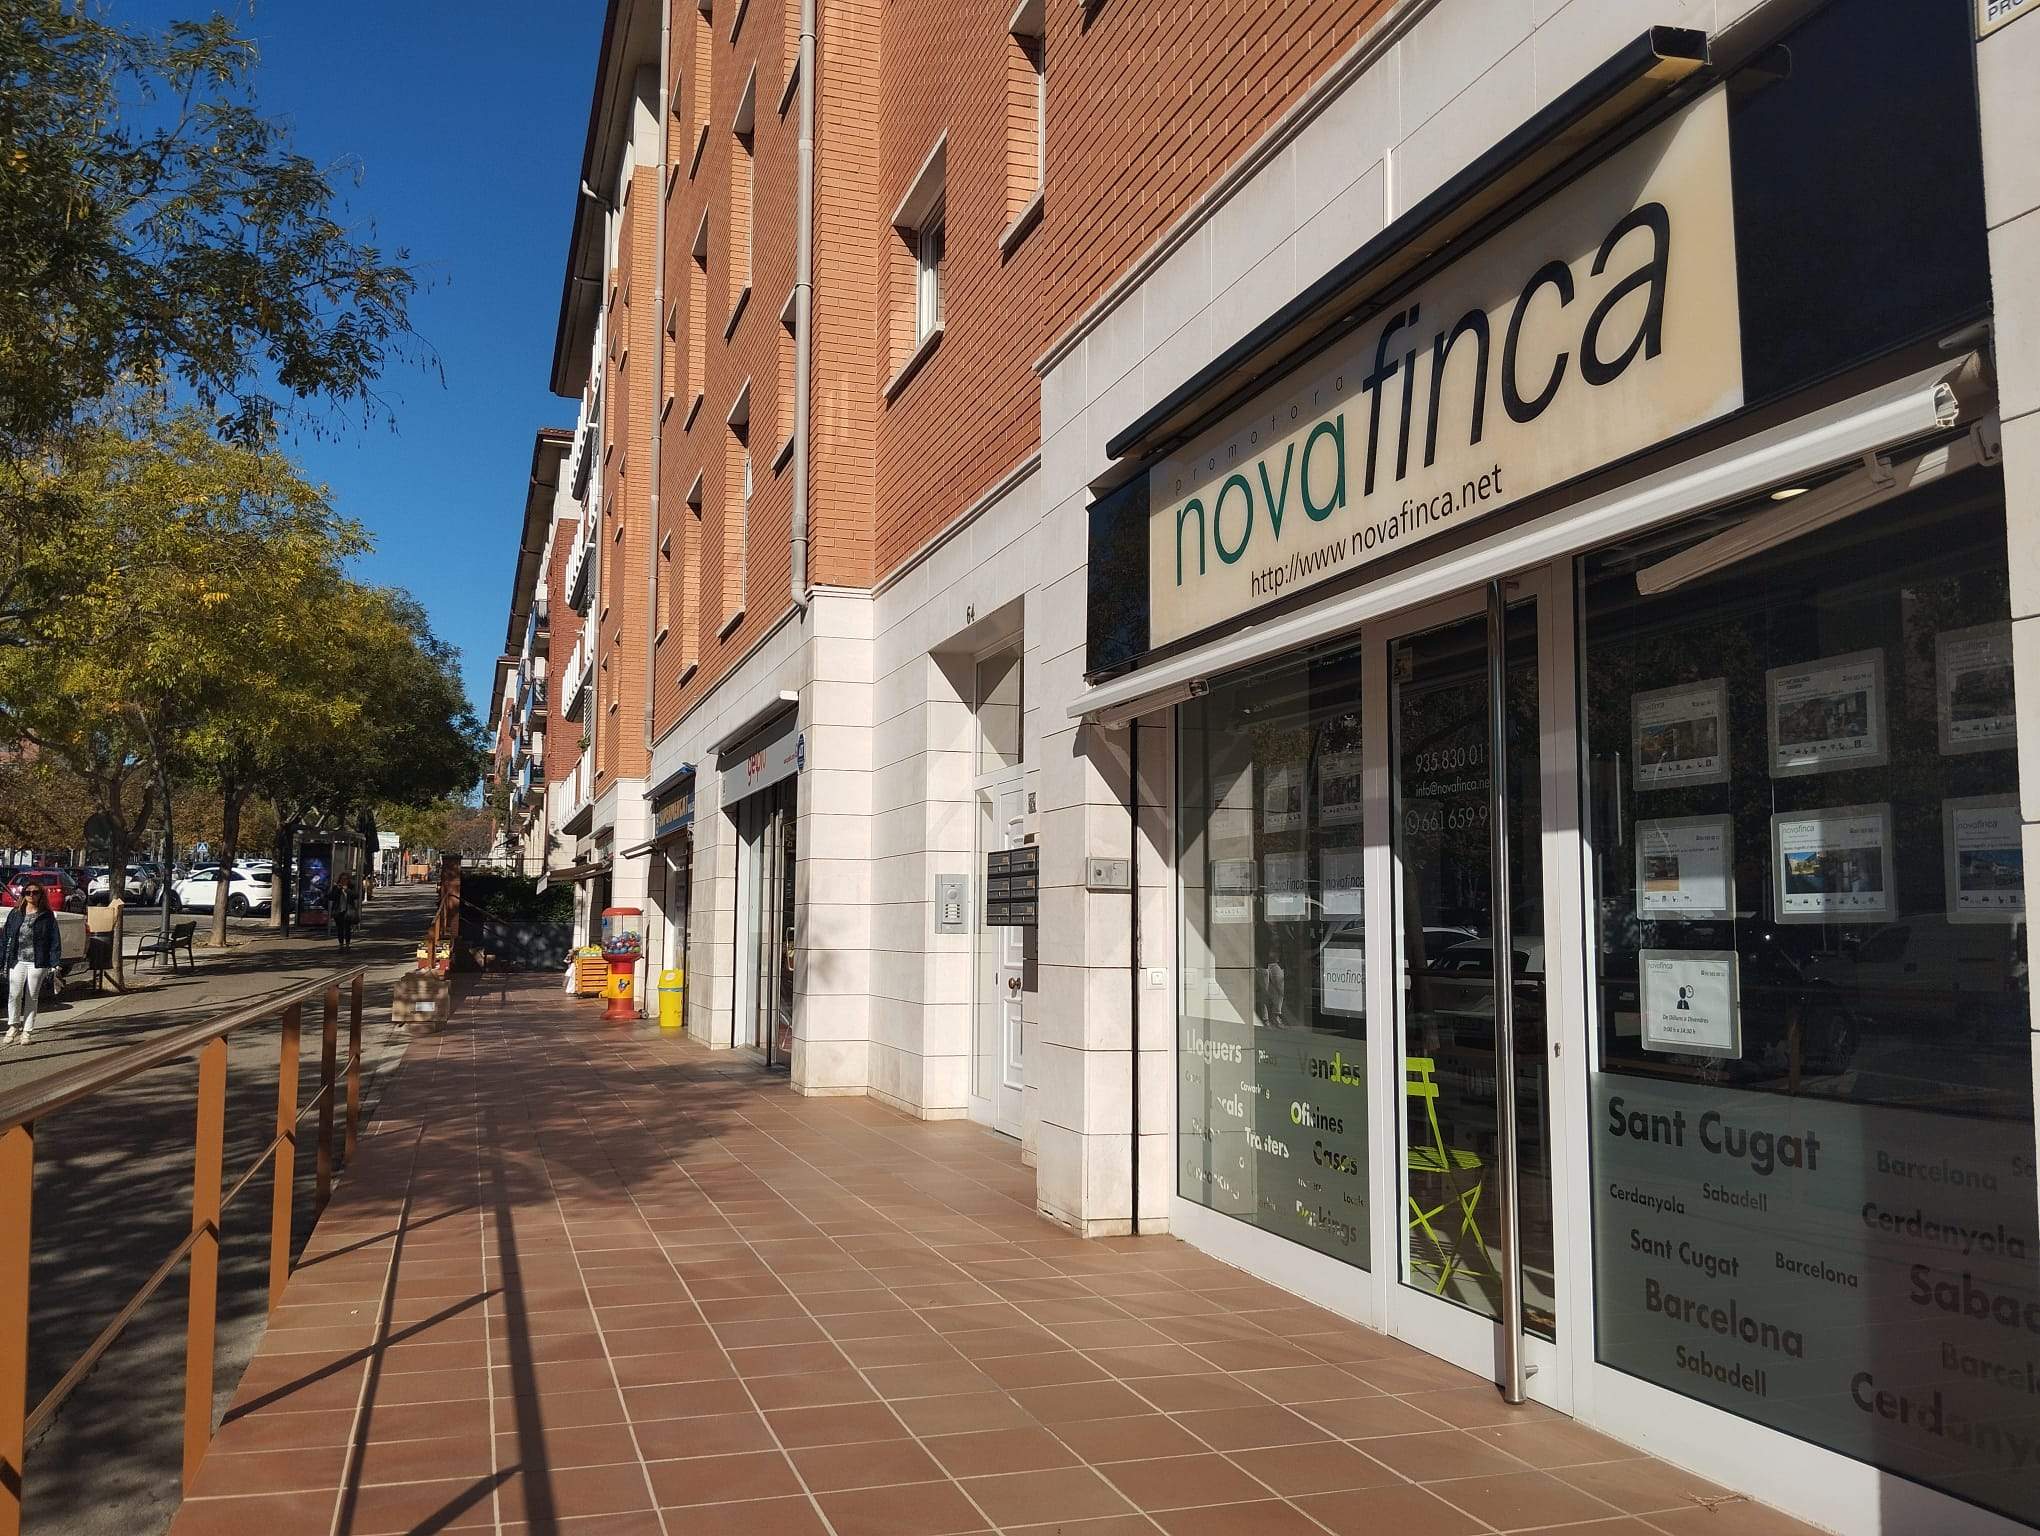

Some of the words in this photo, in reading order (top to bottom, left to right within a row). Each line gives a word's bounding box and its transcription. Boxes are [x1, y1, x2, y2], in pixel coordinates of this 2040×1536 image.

[1175, 376, 1343, 496] promotora
[967, 602, 975, 624] 64
[1415, 752, 1438, 773] 935
[1442, 747, 1465, 769] 830
[1416, 776, 1490, 797] info@novafinca.ne
[1422, 811, 1444, 831] 661
[1448, 807, 1475, 829] 659
[1186, 1029, 1242, 1065] Lloguers
[1296, 1050, 1361, 1087] Vendes
[1290, 1100, 1344, 1135] Oficines
[1608, 1096, 1686, 1147] Sant
[1699, 1110, 1821, 1176] Cugat
[1876, 1150, 1997, 1191] Barcelona
[1610, 1183, 1685, 1215] Cerdanyola
[1702, 1182, 1767, 1212] Sabadell
[1861, 1202, 2026, 1260] Cerdanyola
[1630, 1229, 1672, 1260] Sant
[1679, 1241, 1739, 1279] Cugat
[1775, 1251, 1859, 1289] Barcelona
[1645, 1277, 1804, 1360] Barcelona
[1676, 1345, 1766, 1397] Sabadell
